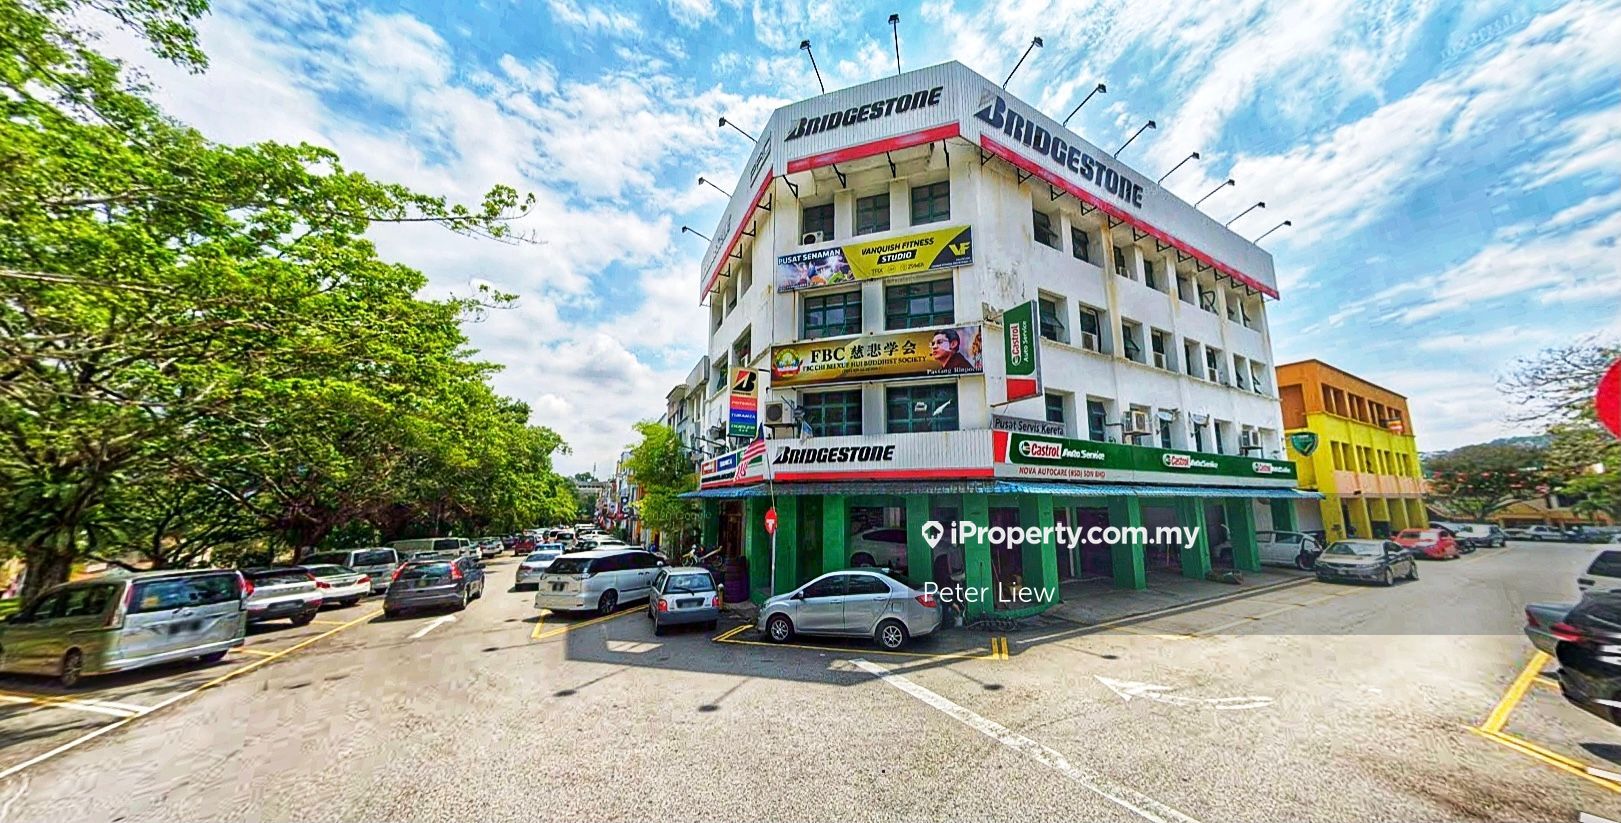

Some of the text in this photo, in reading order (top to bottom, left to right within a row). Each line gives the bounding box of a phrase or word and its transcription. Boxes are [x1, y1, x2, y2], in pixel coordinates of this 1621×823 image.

[784, 86, 944, 142] BRIDGESTONE
[974, 88, 1144, 209] BRIDGESTONE
[861, 237, 935, 256] VANQUISH FITNESS
[778, 248, 842, 266] PUSAT SENAMAN
[881, 251, 912, 263] STUDIO
[1011, 325, 1019, 355] Castrol
[811, 347, 846, 364] FBC
[850, 340, 917, 360] 慈悲学会
[851, 359, 863, 368] HUI
[864, 357, 897, 367] BUDDHIST
[899, 355, 926, 365] SOCIETY
[995, 418, 1065, 436] Pusat Servis Kereta
[773, 444, 895, 464] BRIDGESTONE
[1031, 443, 1060, 458] Castrol
[1080, 449, 1105, 461] Service
[1019, 466, 1036, 475] NOVA
[1037, 467, 1067, 477] AUTOCARE
